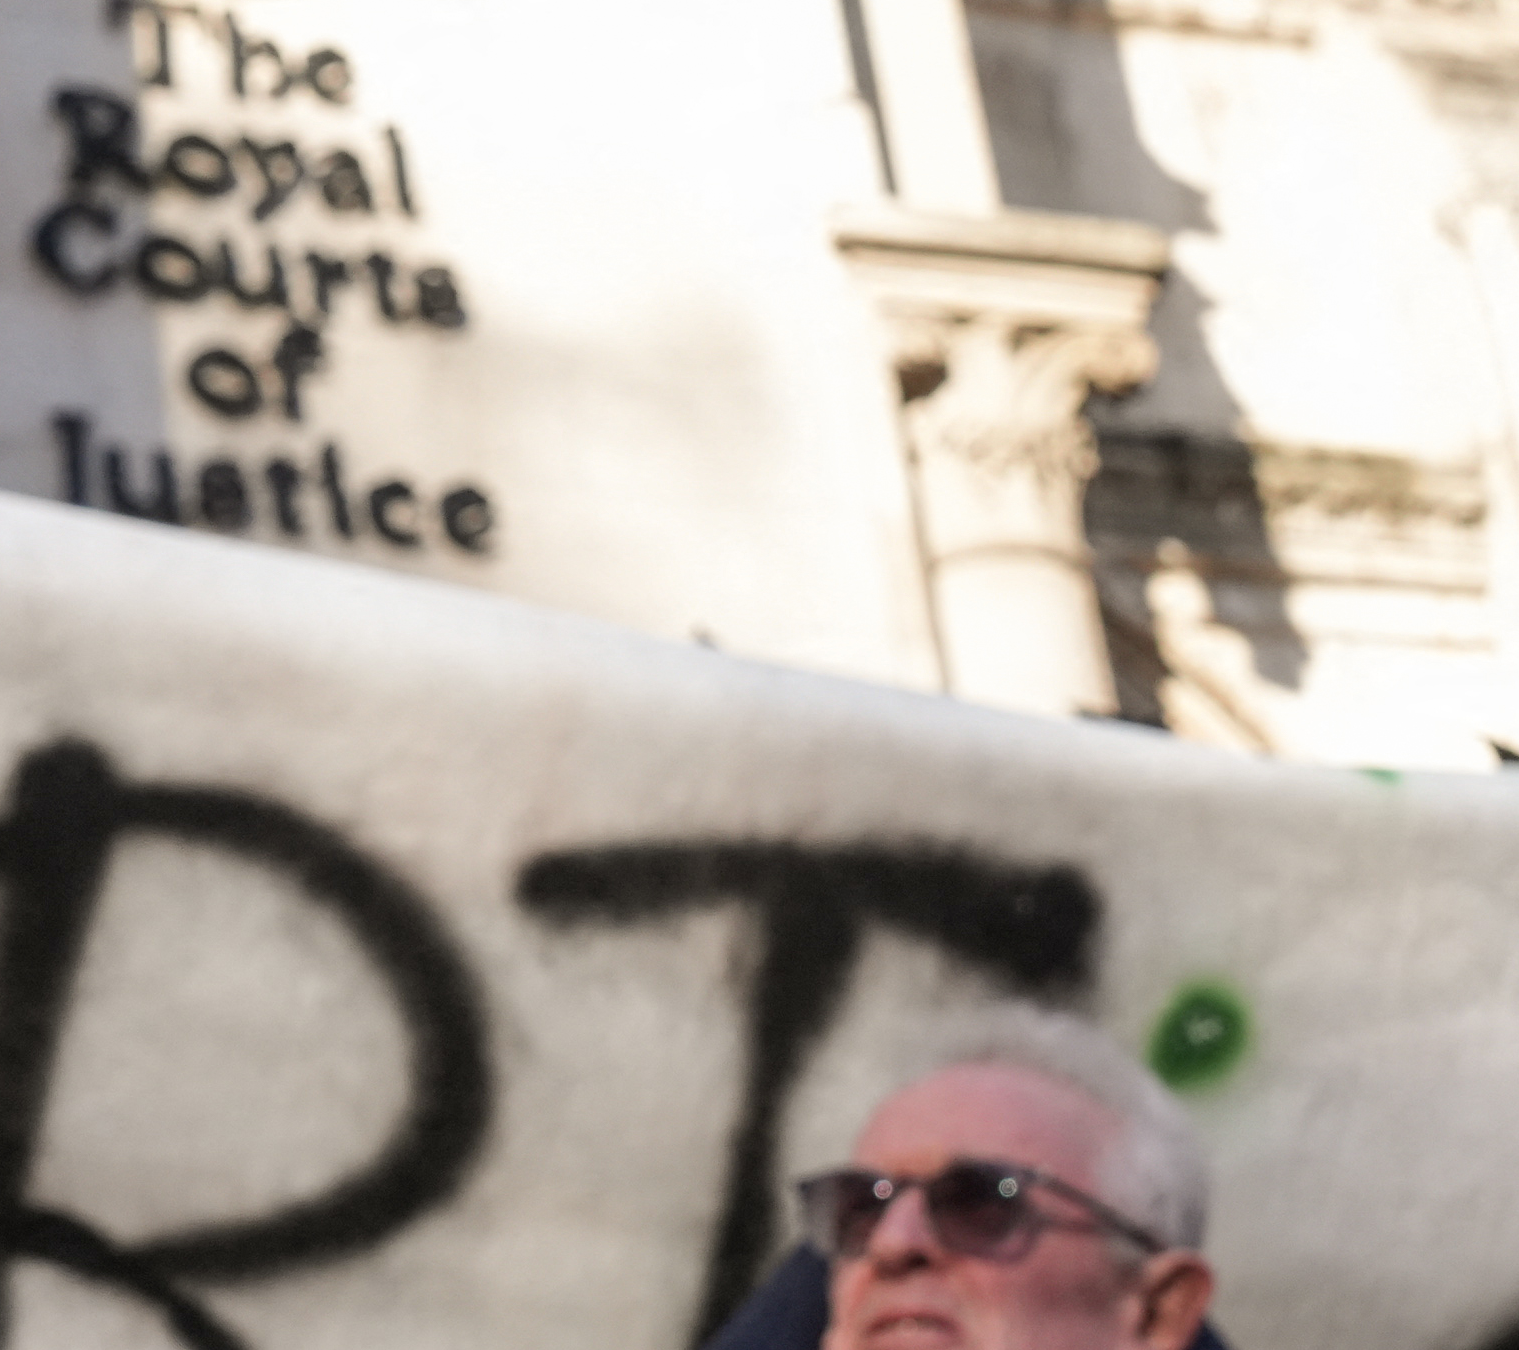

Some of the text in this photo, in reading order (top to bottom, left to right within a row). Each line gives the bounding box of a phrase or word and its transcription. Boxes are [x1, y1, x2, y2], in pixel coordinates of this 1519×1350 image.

[51, 84, 418, 221] Royal
[29, 199, 467, 331] Courts
[189, 324, 325, 421] of
[51, 411, 498, 551] Justice
